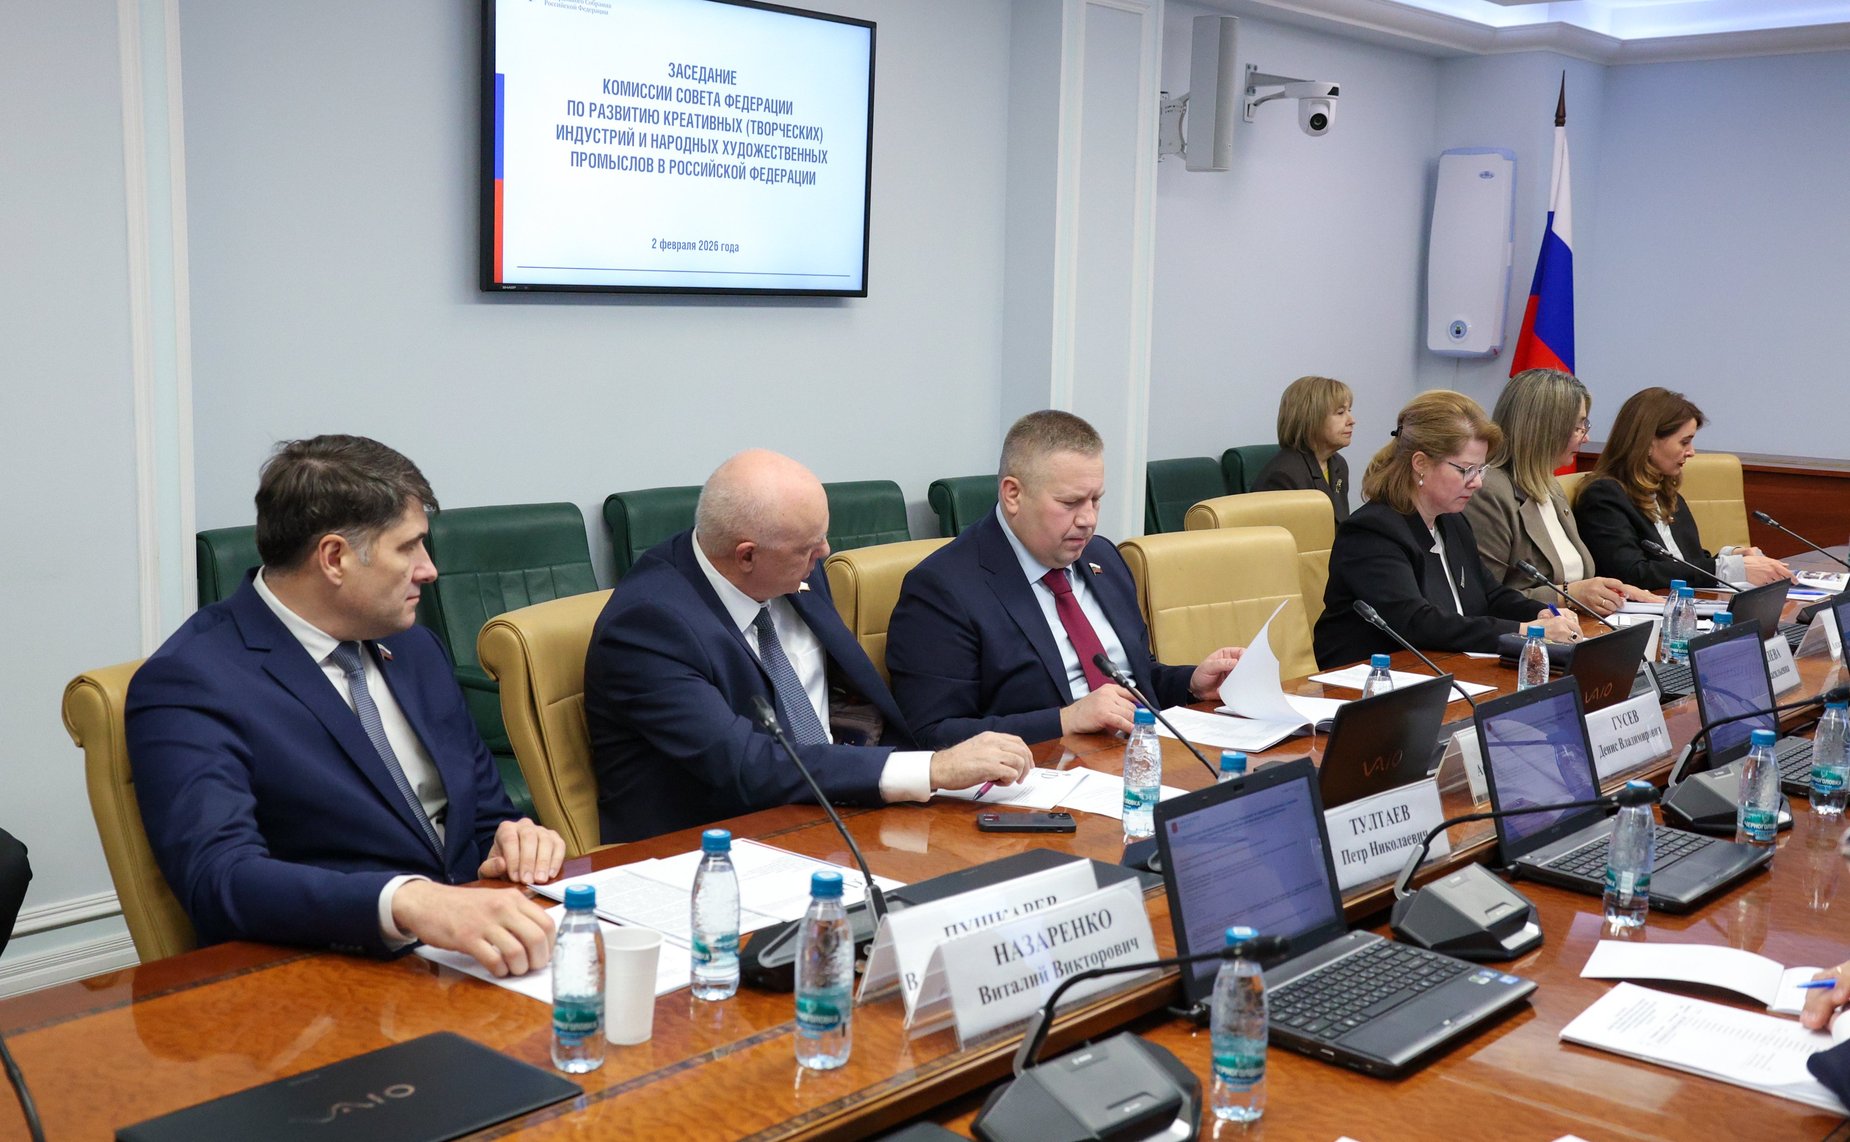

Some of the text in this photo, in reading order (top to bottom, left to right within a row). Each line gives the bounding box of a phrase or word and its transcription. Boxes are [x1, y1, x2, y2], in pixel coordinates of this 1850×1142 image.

[668, 62, 737, 86] ЗАСЕДАНИЕ
[603, 78, 793, 117] КОМИССИИ СОВЕТА ФЕДЕРАЦИИ
[567, 99, 824, 145] ПО РАЗВИТИЮ КРЕАТИВНЫХ (ТВОРЧЕСКИХ)
[556, 124, 828, 165] ИНДУСТРИЙ И НАРОДНЫХ ХУДОЖЕСТВЕННЫХ
[570, 151, 816, 187] ПРОМЫСЛОВ В РОССИЙСКОЙ ФЕДЕРАЦИИ
[651, 237, 740, 254] 2 февраля 2026 года
[1611, 709, 1640, 731] ГУСЕВ
[1598, 743, 1619, 760] Денис
[1349, 804, 1411, 836] ТУЛТАЕВ
[1341, 848, 1369, 865] Петр
[993, 908, 1113, 966] НАЗАРЕНКО
[978, 936, 1140, 1006] Виталий Викторович
